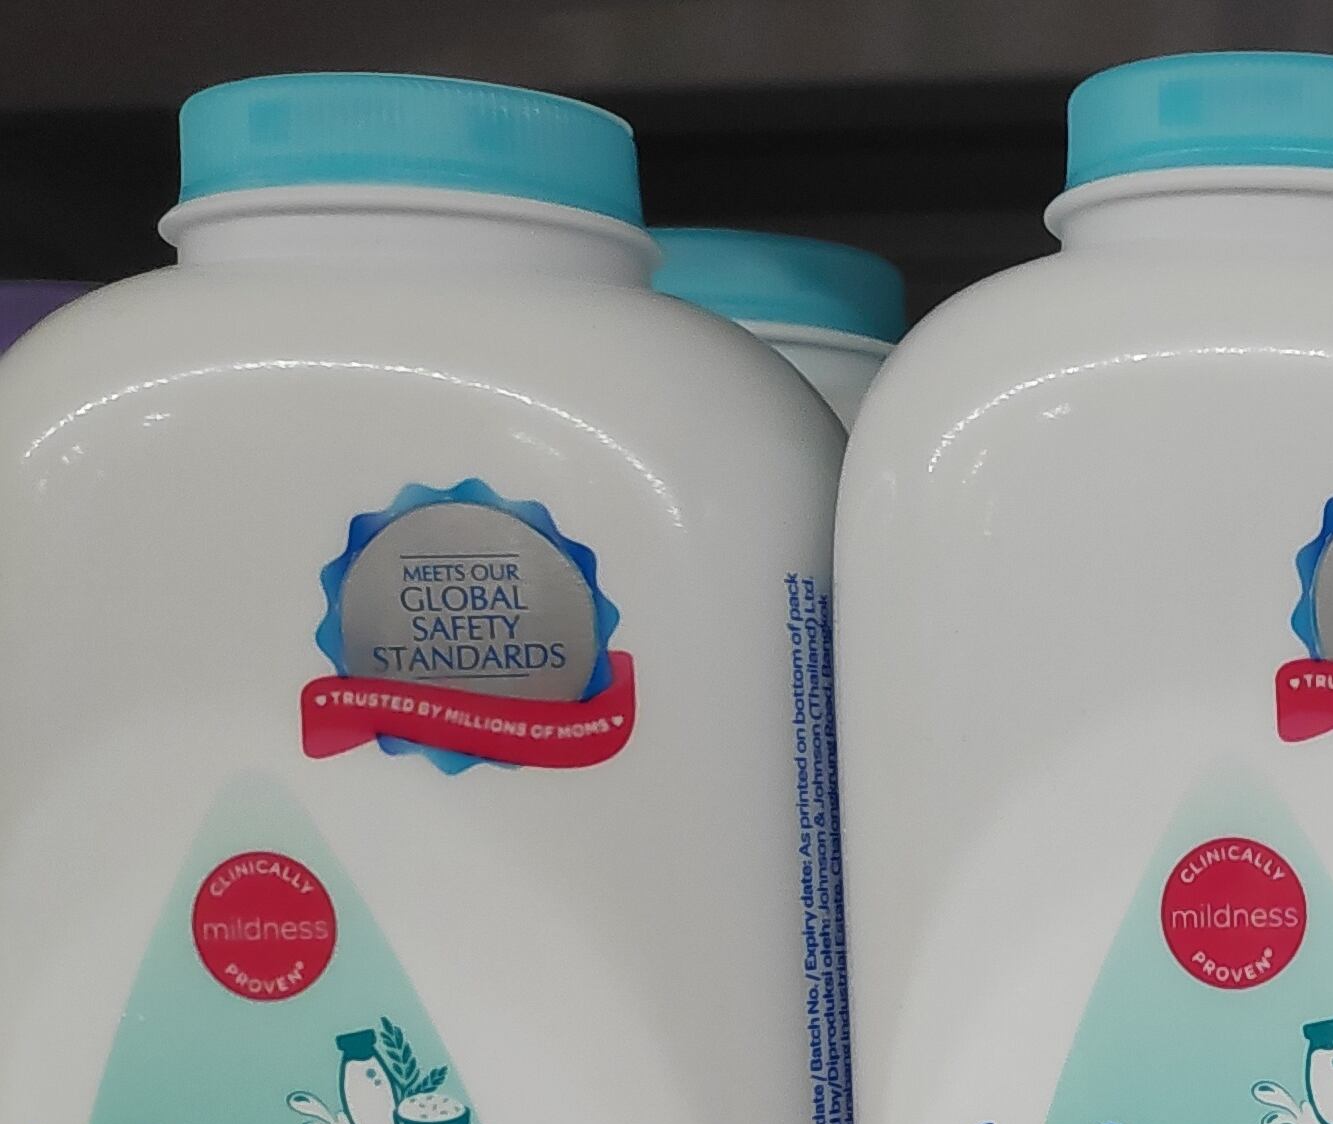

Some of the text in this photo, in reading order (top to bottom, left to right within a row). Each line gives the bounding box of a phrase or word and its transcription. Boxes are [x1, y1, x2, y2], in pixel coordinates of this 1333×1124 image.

[403, 563, 520, 582] MEETS OUR
[401, 585, 528, 612] GLOBAL
[785, 572, 803, 622] pack
[412, 614, 520, 642] SAFETY
[788, 622, 802, 646] of
[373, 643, 566, 672] STANDARDS
[793, 649, 806, 725] bottom
[331, 690, 609, 739] TRUSTED BY MILLIONS OF MOMS
[798, 728, 807, 754] on
[795, 757, 813, 829] printed
[800, 832, 811, 857] As
[210, 860, 315, 897] CLINICALLY
[1180, 845, 1287, 884] CLINICALLY
[802, 861, 814, 908] date:
[203, 916, 328, 941] mildness
[1172, 903, 1299, 929] mildness
[803, 911, 818, 971] Expiry
[808, 984, 820, 1014] No.
[809, 1017, 823, 1072] Batch
